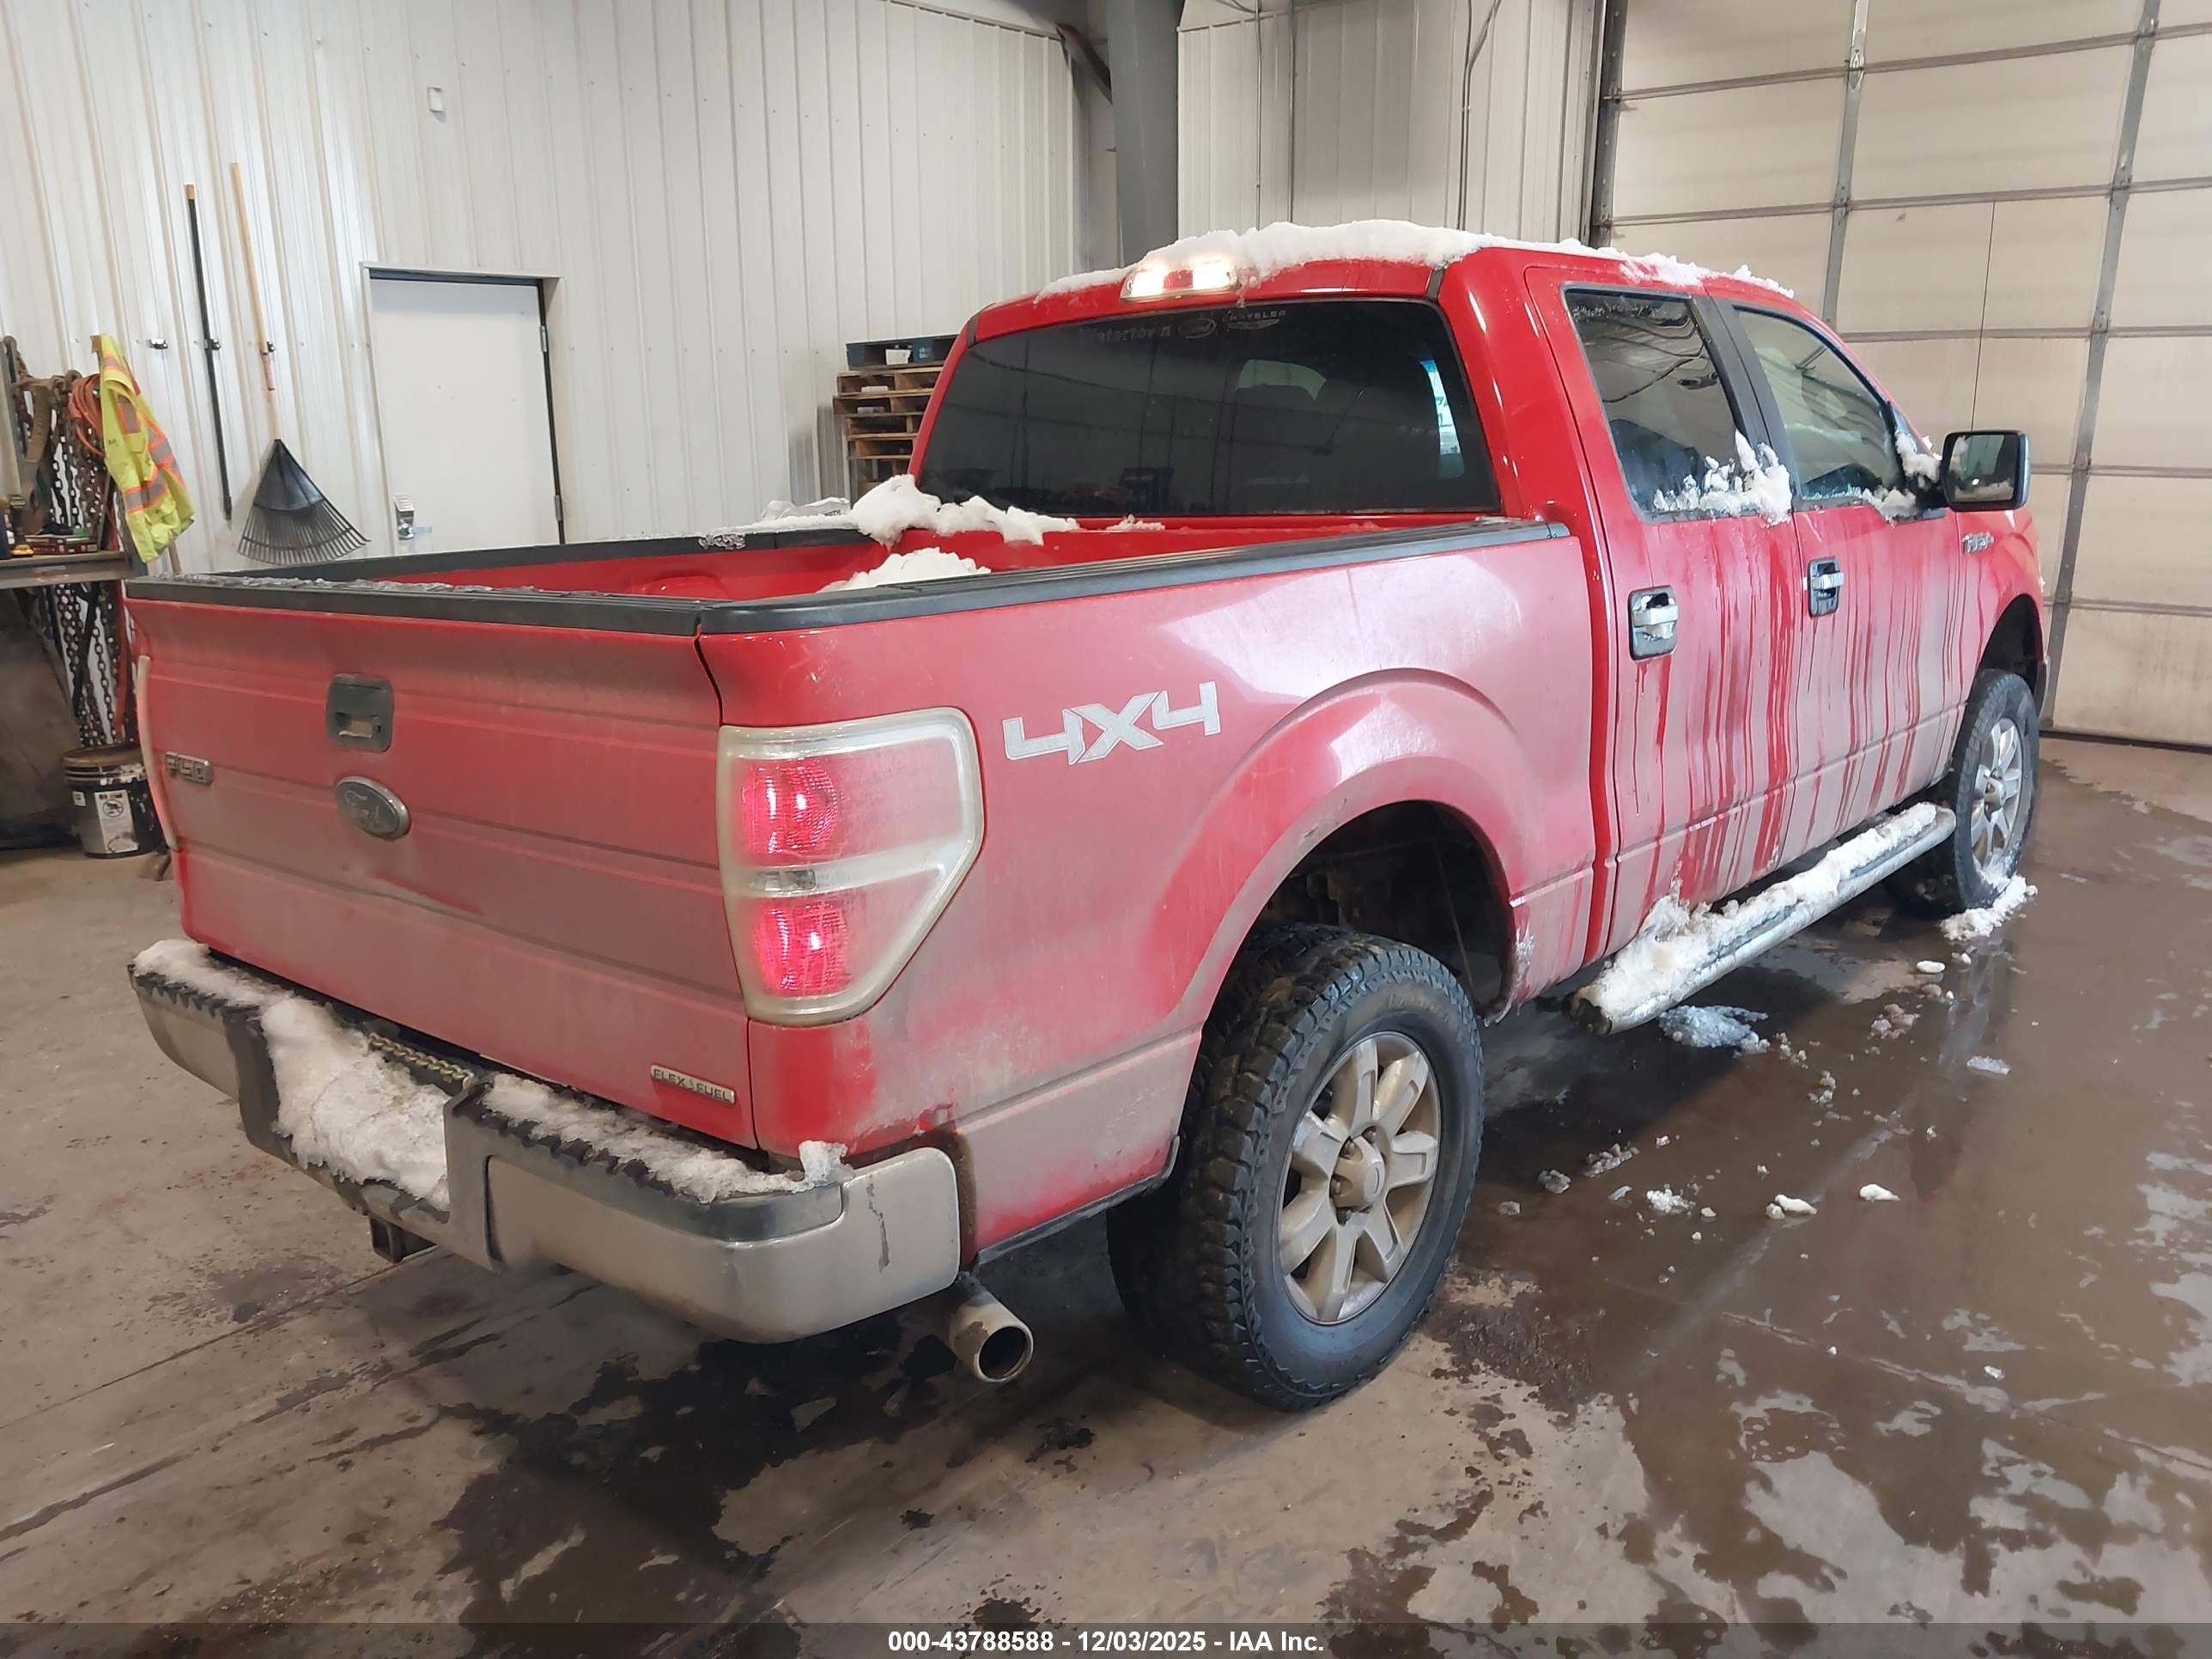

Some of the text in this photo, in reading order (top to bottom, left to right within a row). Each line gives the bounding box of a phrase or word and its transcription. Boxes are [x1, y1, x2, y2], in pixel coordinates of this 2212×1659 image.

[1222, 309, 1286, 324] CHYSLER
[653, 1067, 731, 1103] FLEX FUEL
